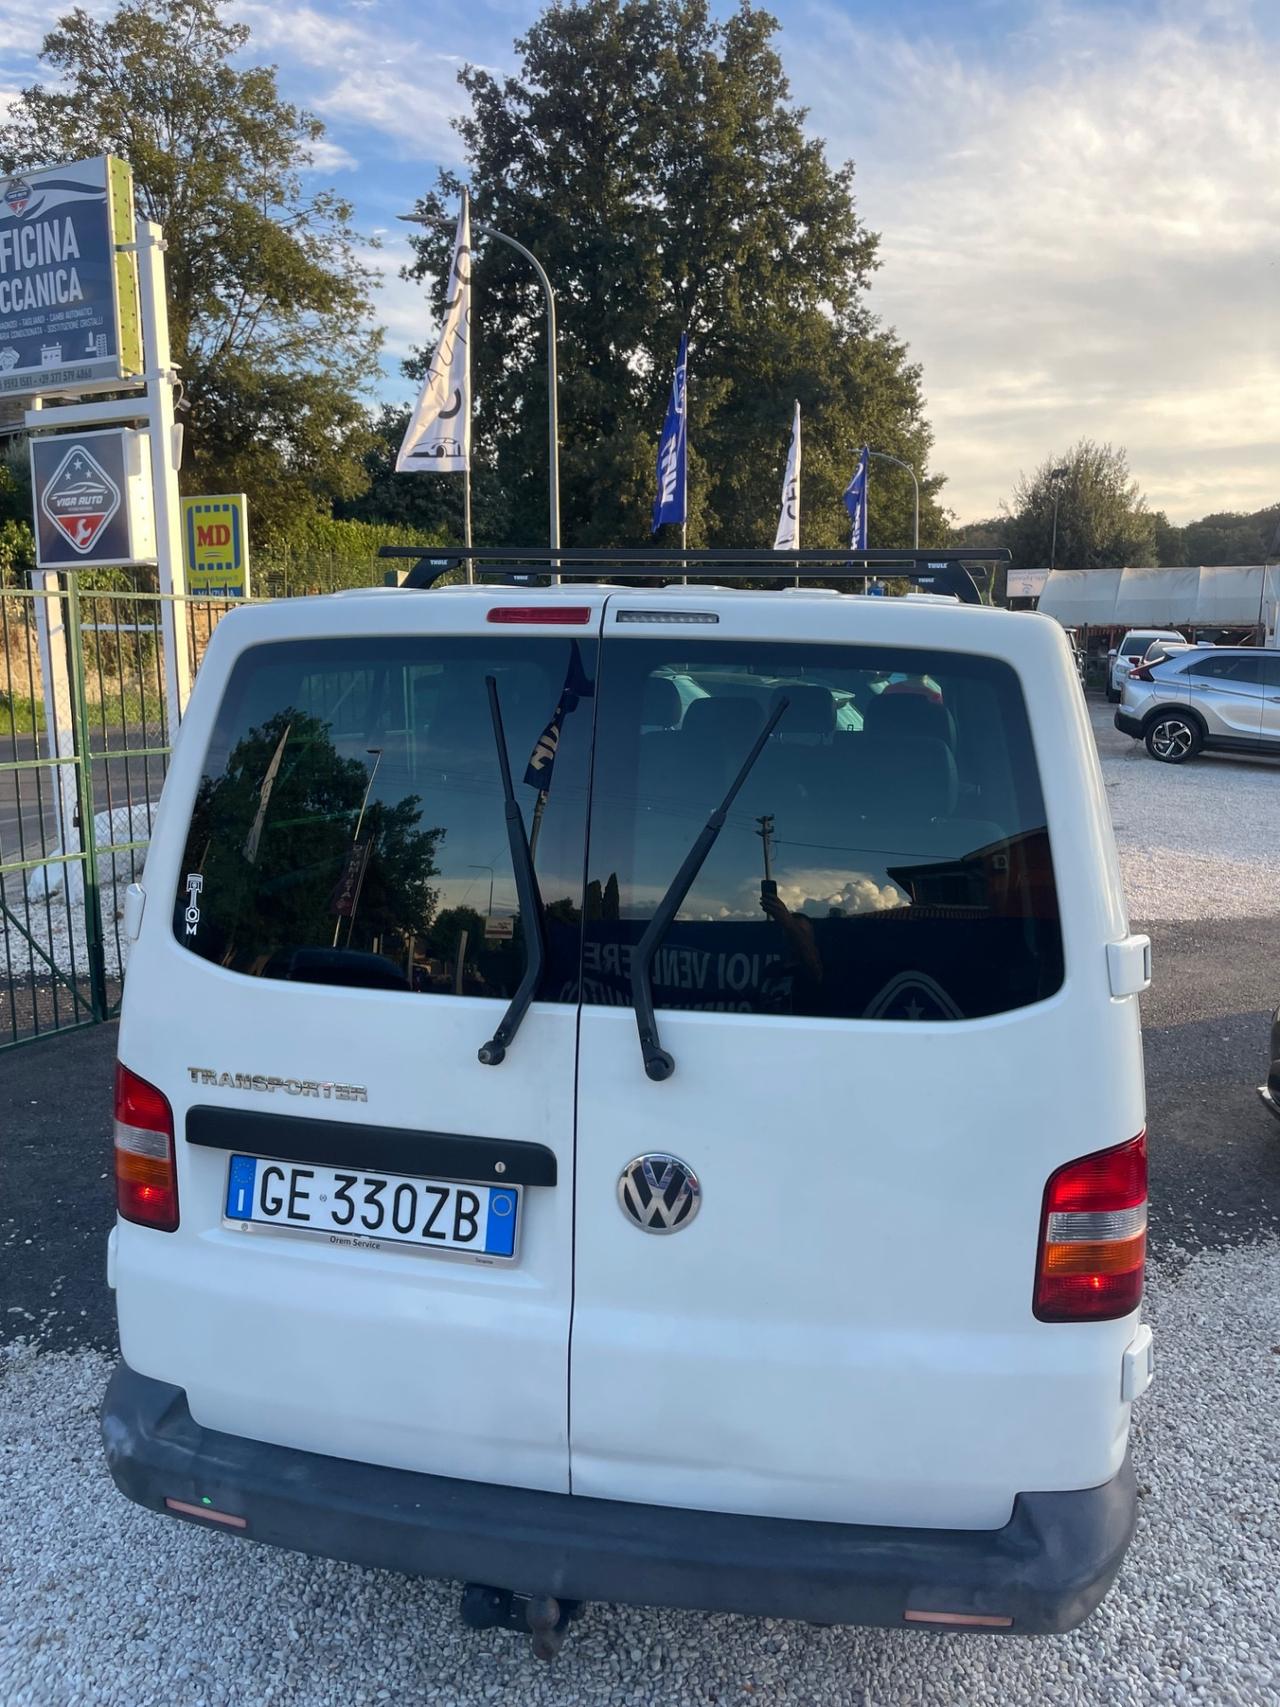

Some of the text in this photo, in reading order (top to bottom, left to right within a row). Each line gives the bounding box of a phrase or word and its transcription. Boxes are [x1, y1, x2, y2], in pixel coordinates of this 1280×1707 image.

[0, 267, 83, 313] CCANICA
[57, 495, 103, 507] VIGA AUTO
[196, 524, 231, 548] MD
[187, 1066, 368, 1102] TRANSPORTER
[259, 1166, 315, 1221] GE
[331, 1173, 481, 1244] 330ZB
[329, 1235, 381, 1250] Orem Service
